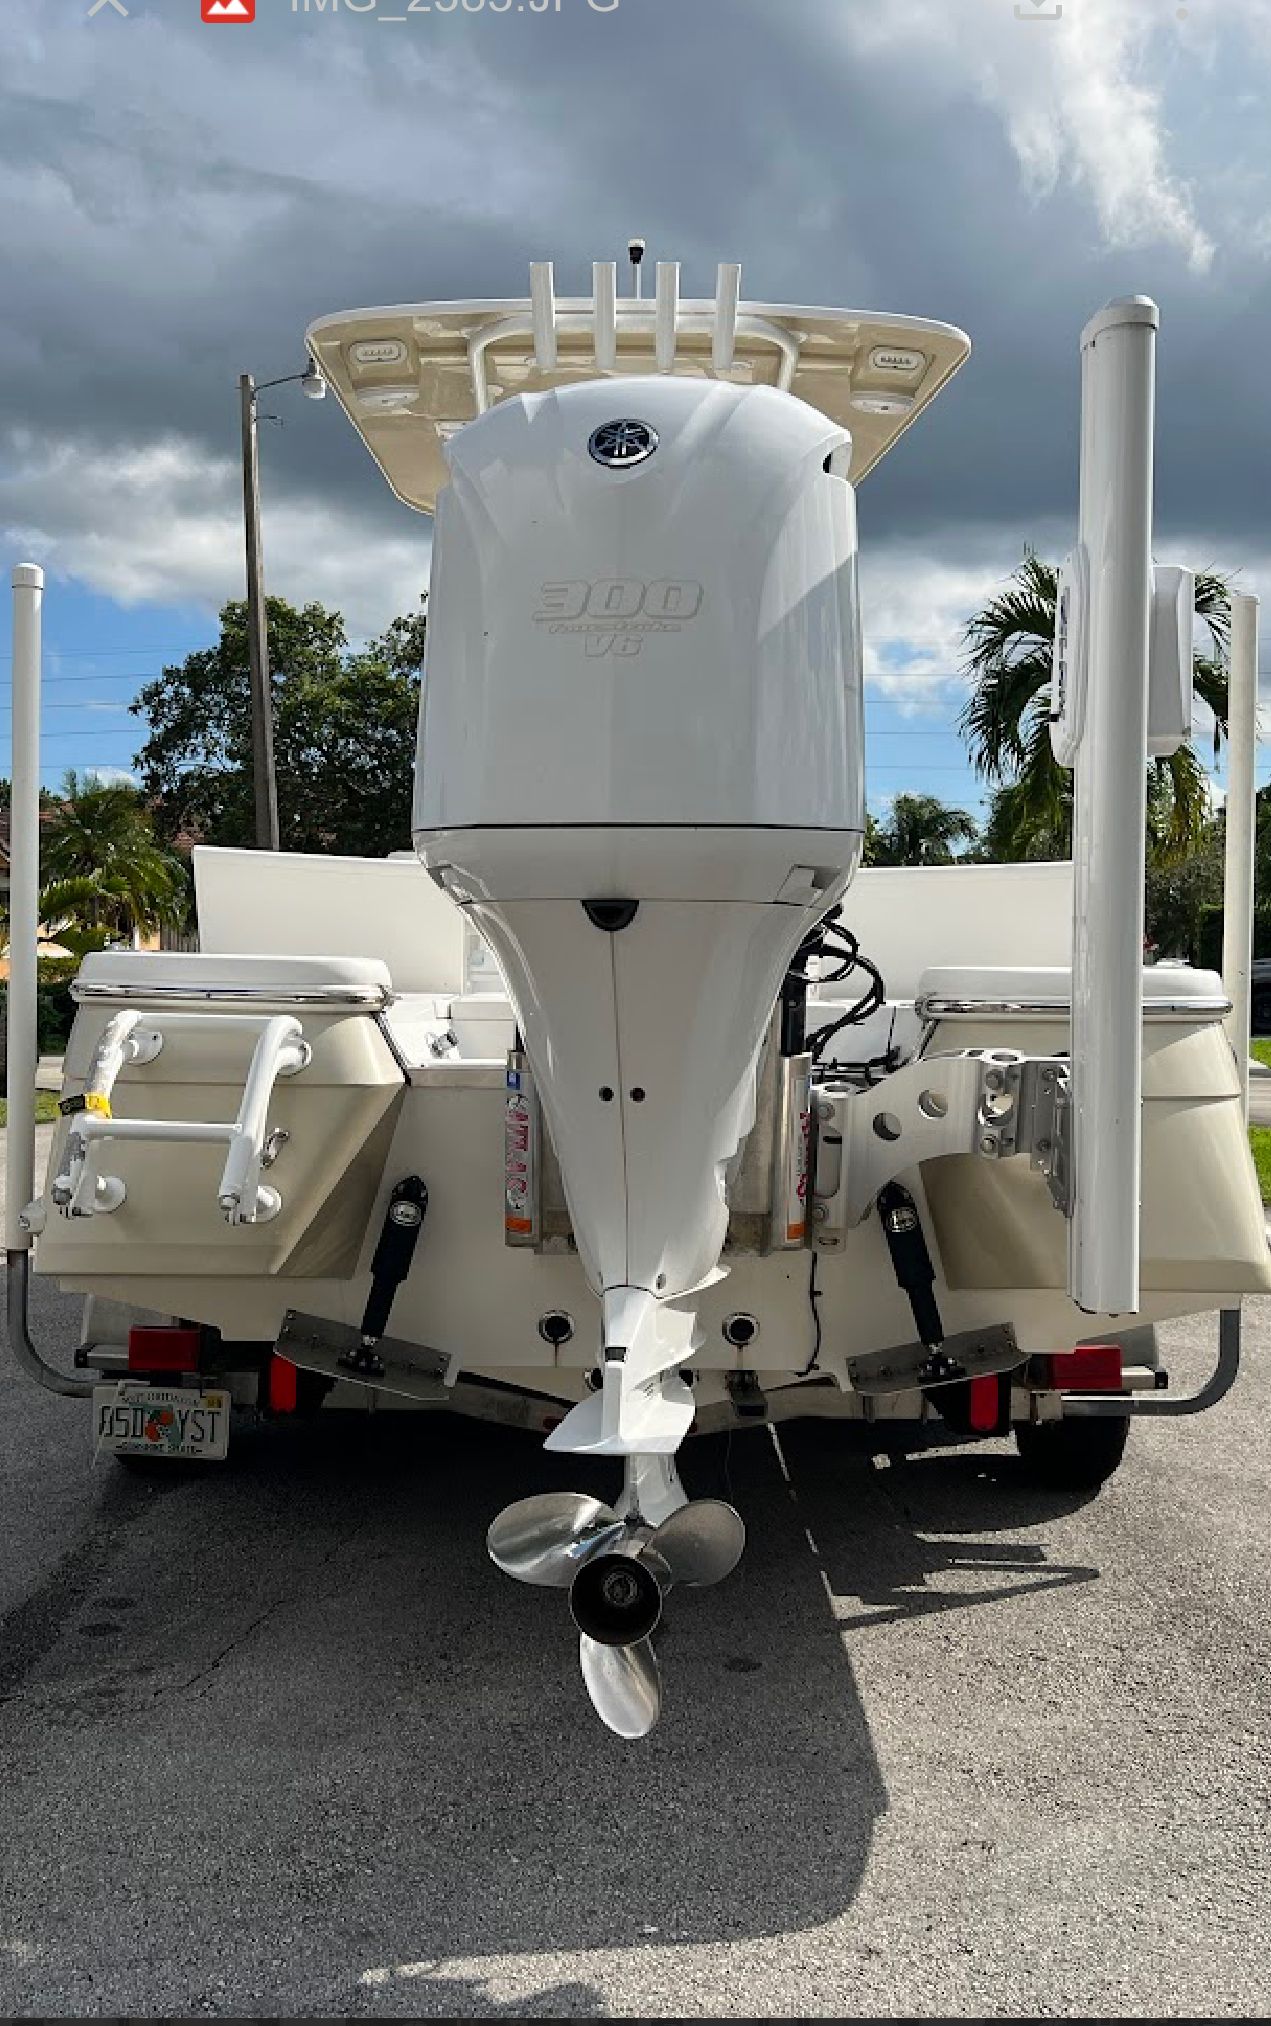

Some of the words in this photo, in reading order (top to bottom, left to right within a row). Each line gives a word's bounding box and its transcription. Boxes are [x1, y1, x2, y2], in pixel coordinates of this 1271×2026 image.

[532, 578, 704, 622] 300
[585, 633, 644, 658] V6
[177, 1409, 222, 1443] YST
